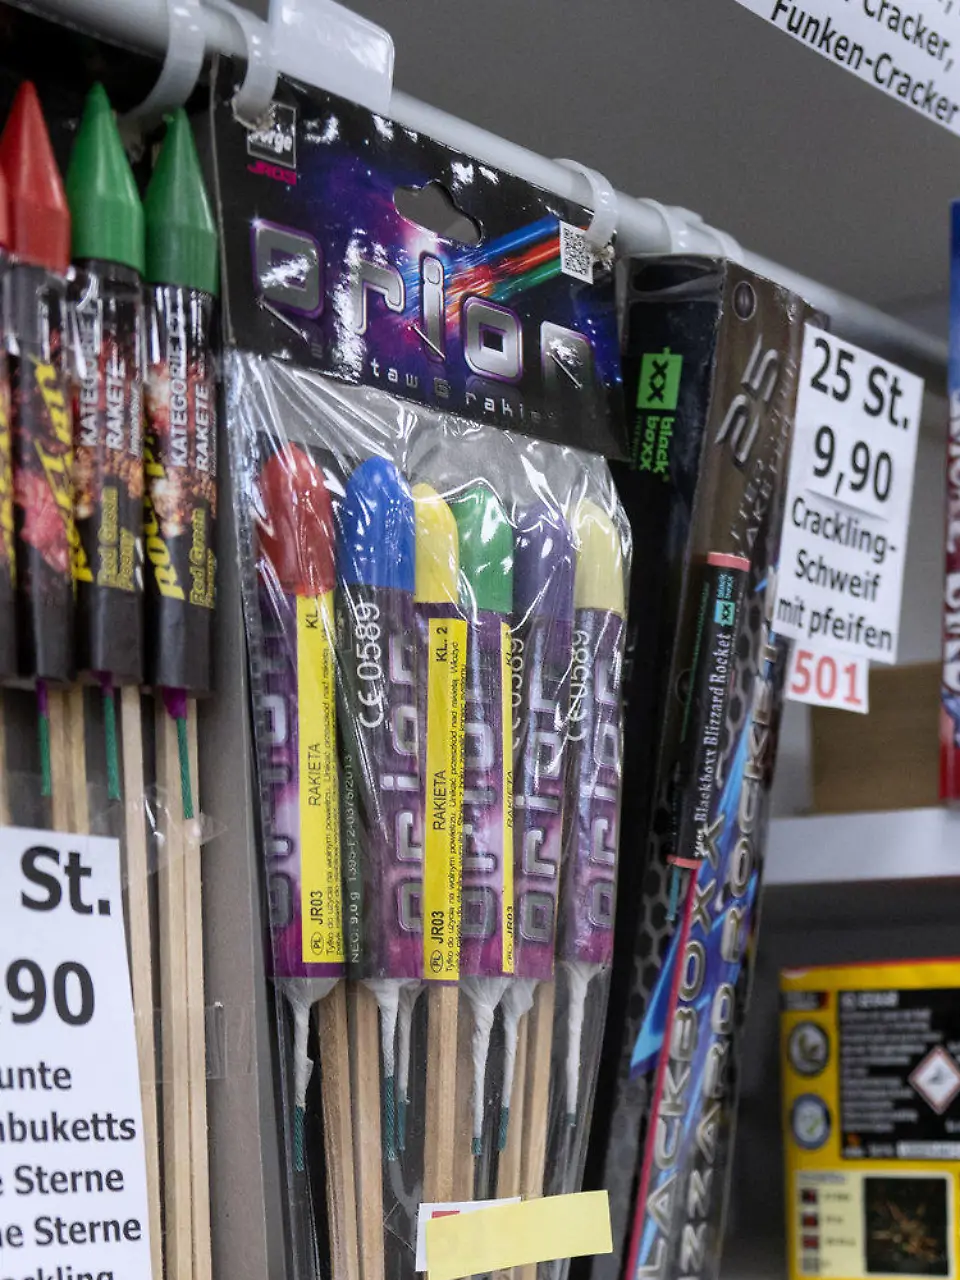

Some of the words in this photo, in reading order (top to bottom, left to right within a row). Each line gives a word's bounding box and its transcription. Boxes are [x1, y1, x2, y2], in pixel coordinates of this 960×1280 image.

[770, 0, 959, 124] Funken-Cracker
[250, 218, 596, 390] orion
[810, 337, 855, 404] 25
[862, 365, 911, 431] St.
[195, 383, 210, 472] RAKETE
[811, 424, 894, 503] 9,90
[791, 496, 899, 566] Crackling-
[795, 548, 882, 604] Schweif
[356, 601, 383, 681] 0589
[436, 626, 448, 636] 2
[436, 638, 448, 662] KL.
[776, 596, 806, 628] mit
[807, 603, 893, 653] pfeifen
[709, 633, 732, 684] Rocket
[789, 647, 864, 706] 501
[703, 687, 726, 747] Blizzard
[307, 742, 322, 807] RAKIETA
[432, 770, 447, 831] RAKIETA
[694, 749, 718, 823] Blackboxx
[20, 844, 111, 917] St.
[308, 889, 324, 927] JR03
[430, 910, 445, 945] JR03
[430, 950, 444, 973] PL
[0, 957, 96, 1028] 90
[0, 1062, 72, 1091] unte
[14, 1163, 125, 1196] Sterne
[34, 1215, 143, 1247] Sterne
